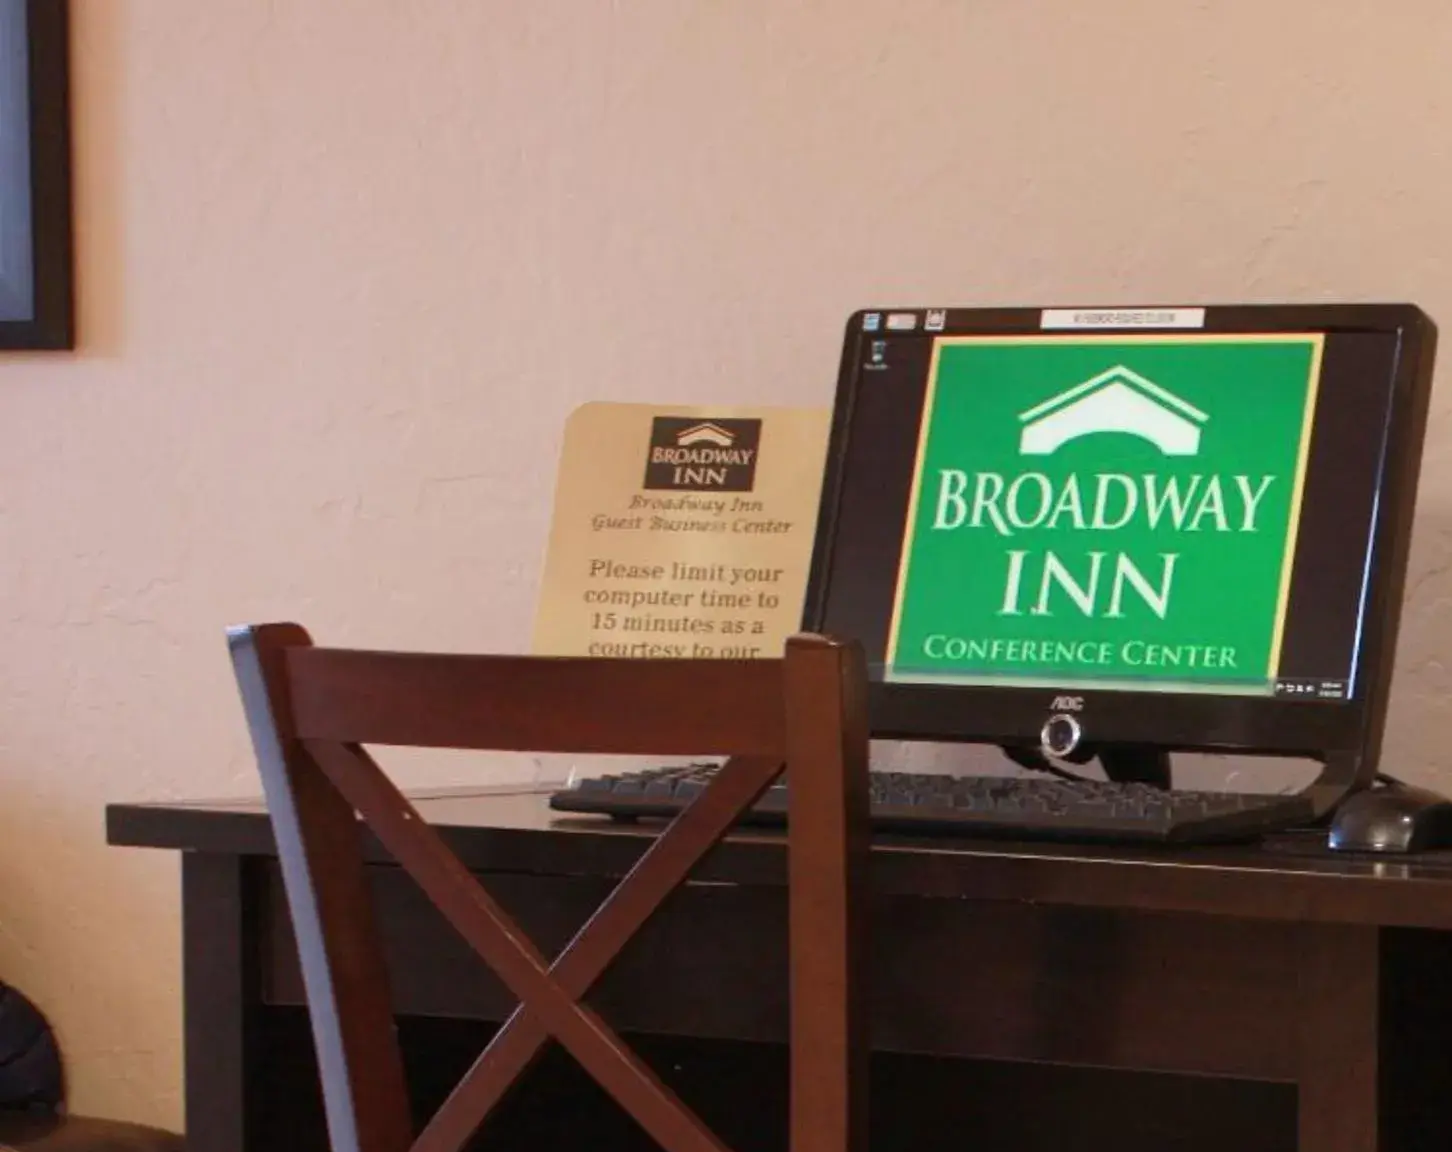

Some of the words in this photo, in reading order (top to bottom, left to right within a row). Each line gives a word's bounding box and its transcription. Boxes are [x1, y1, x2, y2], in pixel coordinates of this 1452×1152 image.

[652, 446, 755, 465] BROADWAY
[673, 467, 728, 485] INN
[628, 495, 726, 516] Broadway
[730, 497, 764, 513] Inn
[932, 469, 1277, 536] BROADWAY
[591, 514, 644, 532] Guest
[649, 516, 727, 533] Business
[732, 519, 794, 534] Center
[589, 559, 665, 580] Please
[671, 562, 726, 581] limit
[730, 568, 785, 585] your
[998, 551, 1180, 619] INN
[583, 589, 695, 609] computer
[700, 590, 752, 608] time
[757, 591, 780, 609] to
[591, 612, 618, 631] 15
[622, 614, 715, 633] minutes
[721, 620, 746, 634] as
[750, 621, 765, 634] a
[692, 642, 715, 659] to
[1049, 696, 1085, 711] AOC
